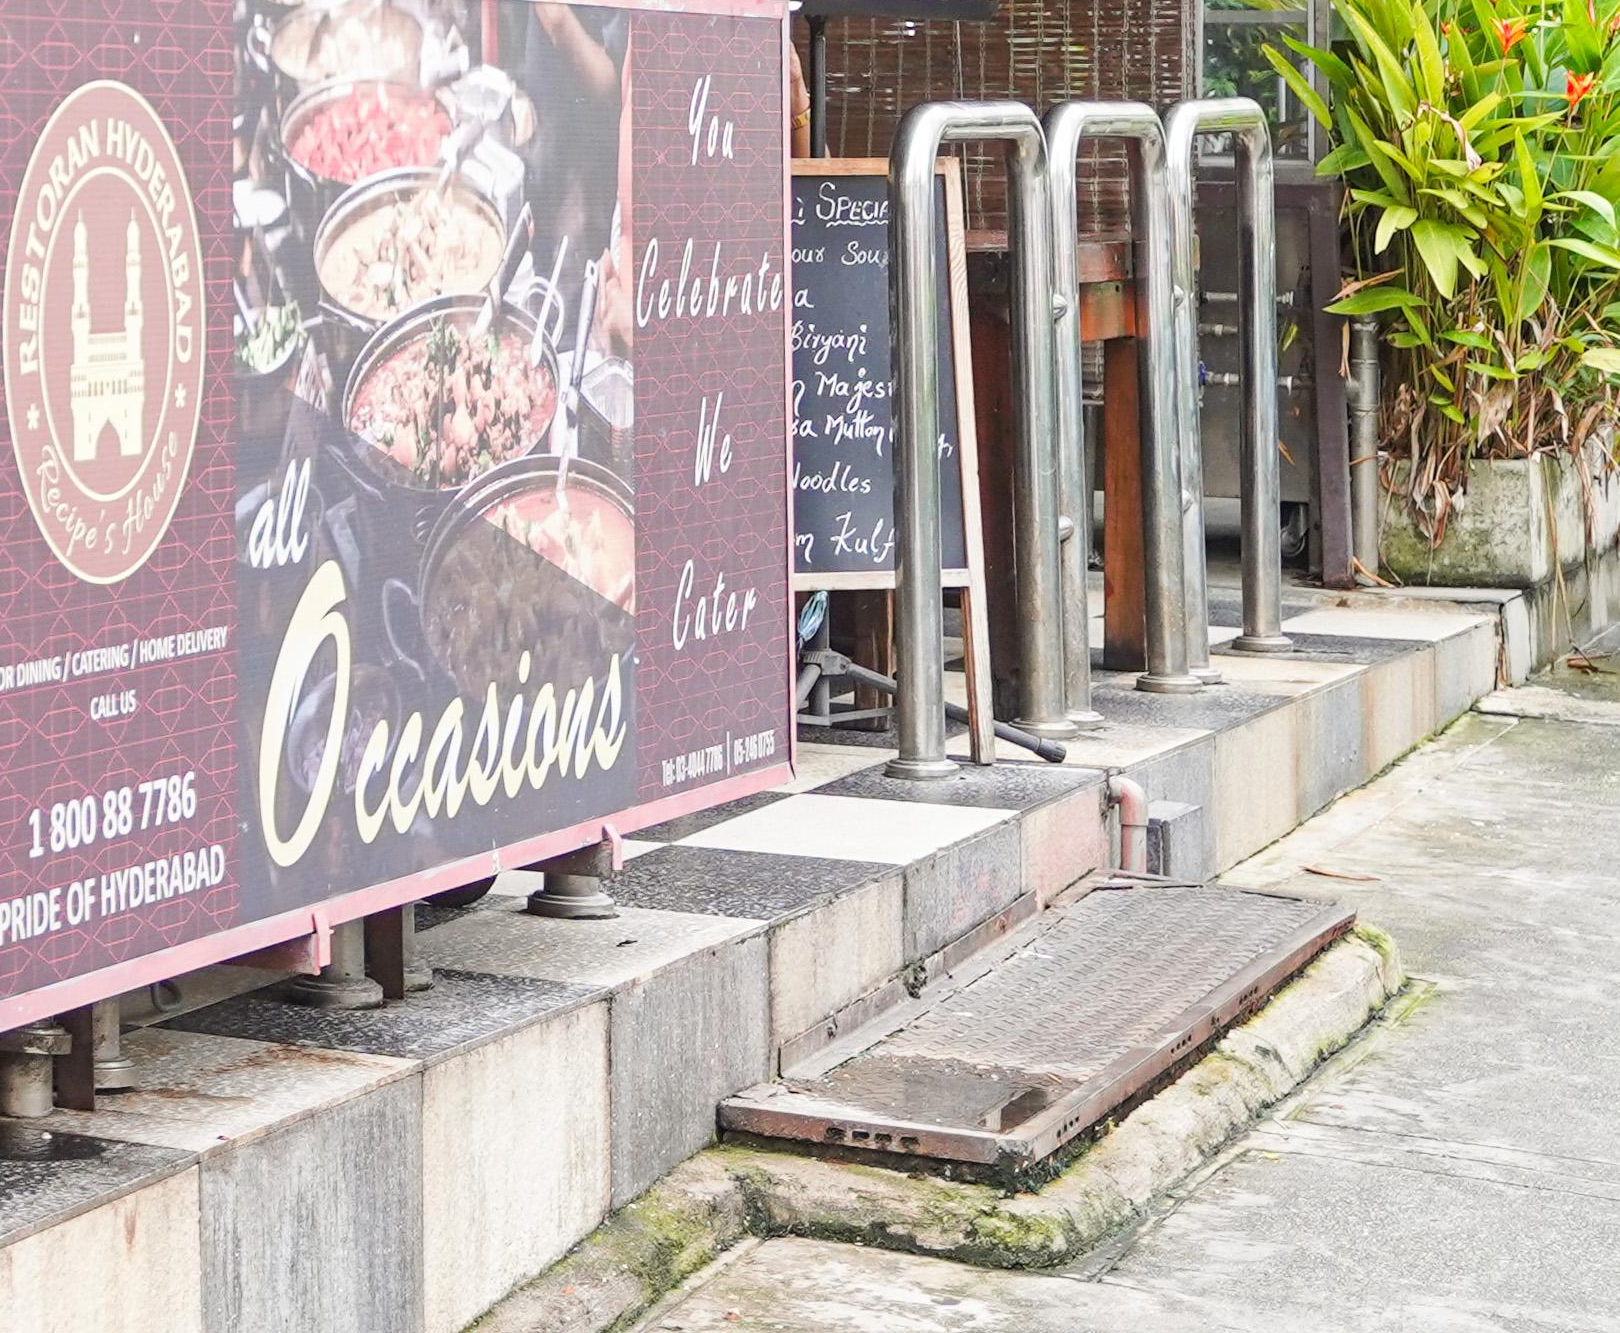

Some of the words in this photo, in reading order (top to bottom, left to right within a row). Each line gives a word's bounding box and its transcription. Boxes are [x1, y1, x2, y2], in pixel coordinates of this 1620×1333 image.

[688, 74, 734, 166] You
[18, 118, 101, 376] RESTORAN
[106, 117, 193, 365] HYDERABAD
[636, 237, 783, 328] Celebrate
[791, 246, 826, 264] our
[694, 391, 733, 487] We
[37, 444, 115, 557] Recipe's
[122, 431, 178, 555] House
[248, 457, 311, 569] all
[830, 511, 895, 563] Kulf
[672, 558, 757, 651] Cater
[16, 662, 61, 689] DINING
[72, 643, 129, 677] CATERING
[139, 634, 175, 664] HOME
[176, 625, 228, 657] DELIVERY
[90, 694, 119, 721] CALL
[119, 689, 137, 715] US
[259, 559, 627, 868] Occasions
[28, 808, 45, 859] 1
[49, 795, 97, 854] 800
[102, 786, 134, 840] 88
[137, 771, 198, 830] 7786
[65, 875, 97, 927] OF
[100, 843, 225, 917] HYDERABAD
